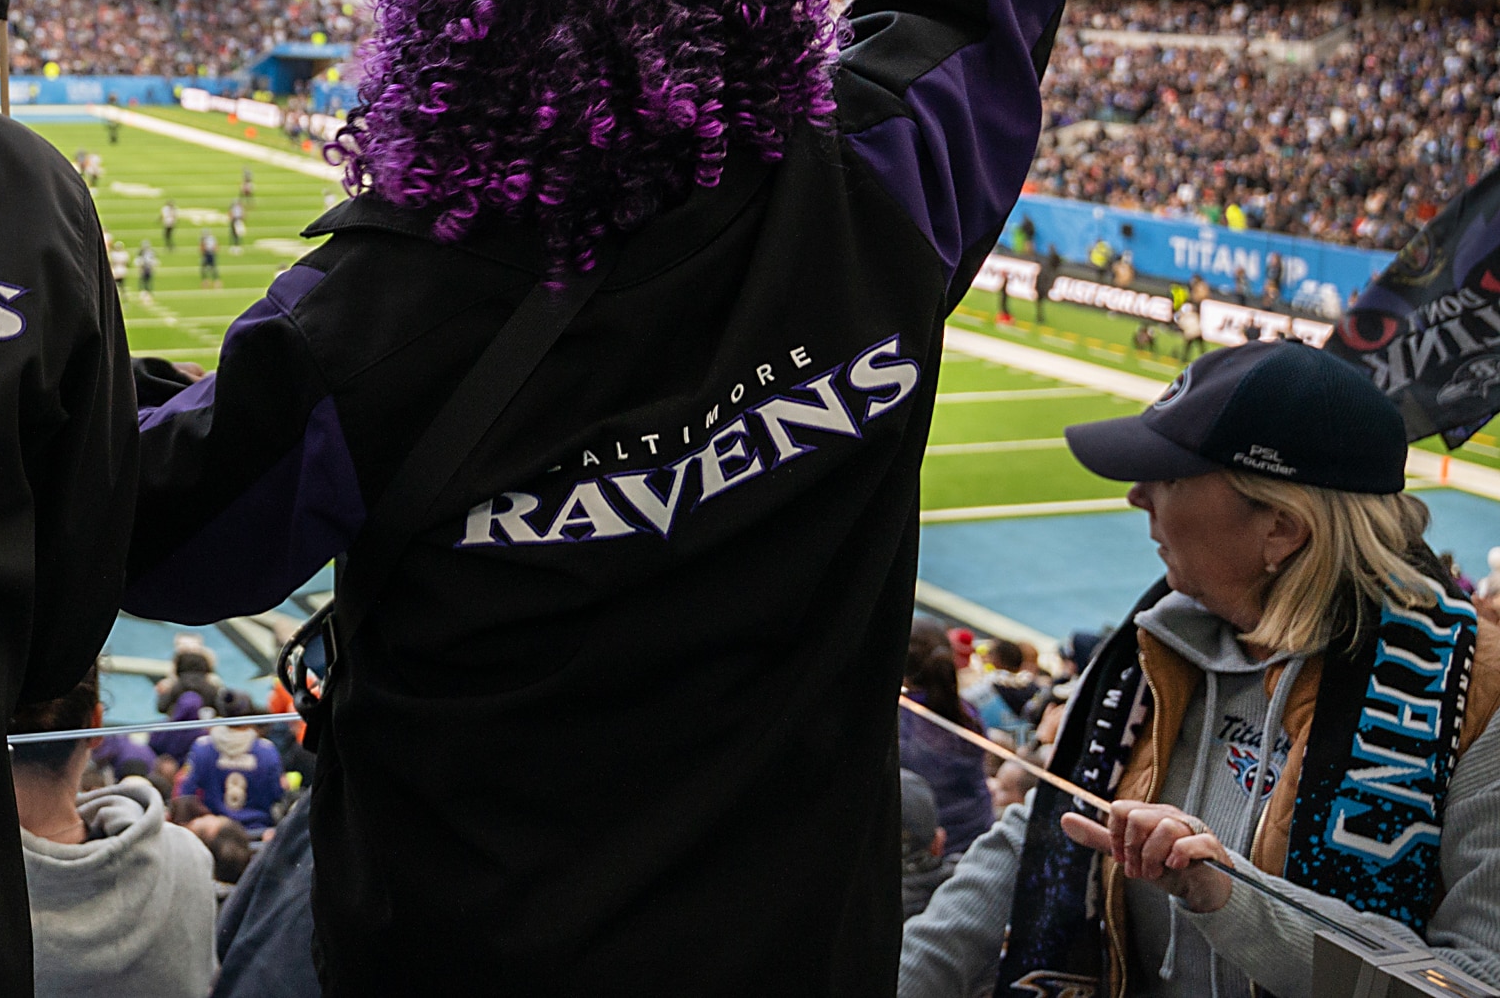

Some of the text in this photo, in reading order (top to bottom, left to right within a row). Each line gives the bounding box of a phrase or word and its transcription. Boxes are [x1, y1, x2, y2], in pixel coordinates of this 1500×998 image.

[1170, 236, 1260, 282] TITAN
[548, 345, 812, 473] ALTIMORE
[453, 333, 920, 549] RAVENS
[1249, 443, 1283, 464] PSL
[1233, 452, 1297, 476] Founder
[224, 771, 248, 811] 8
